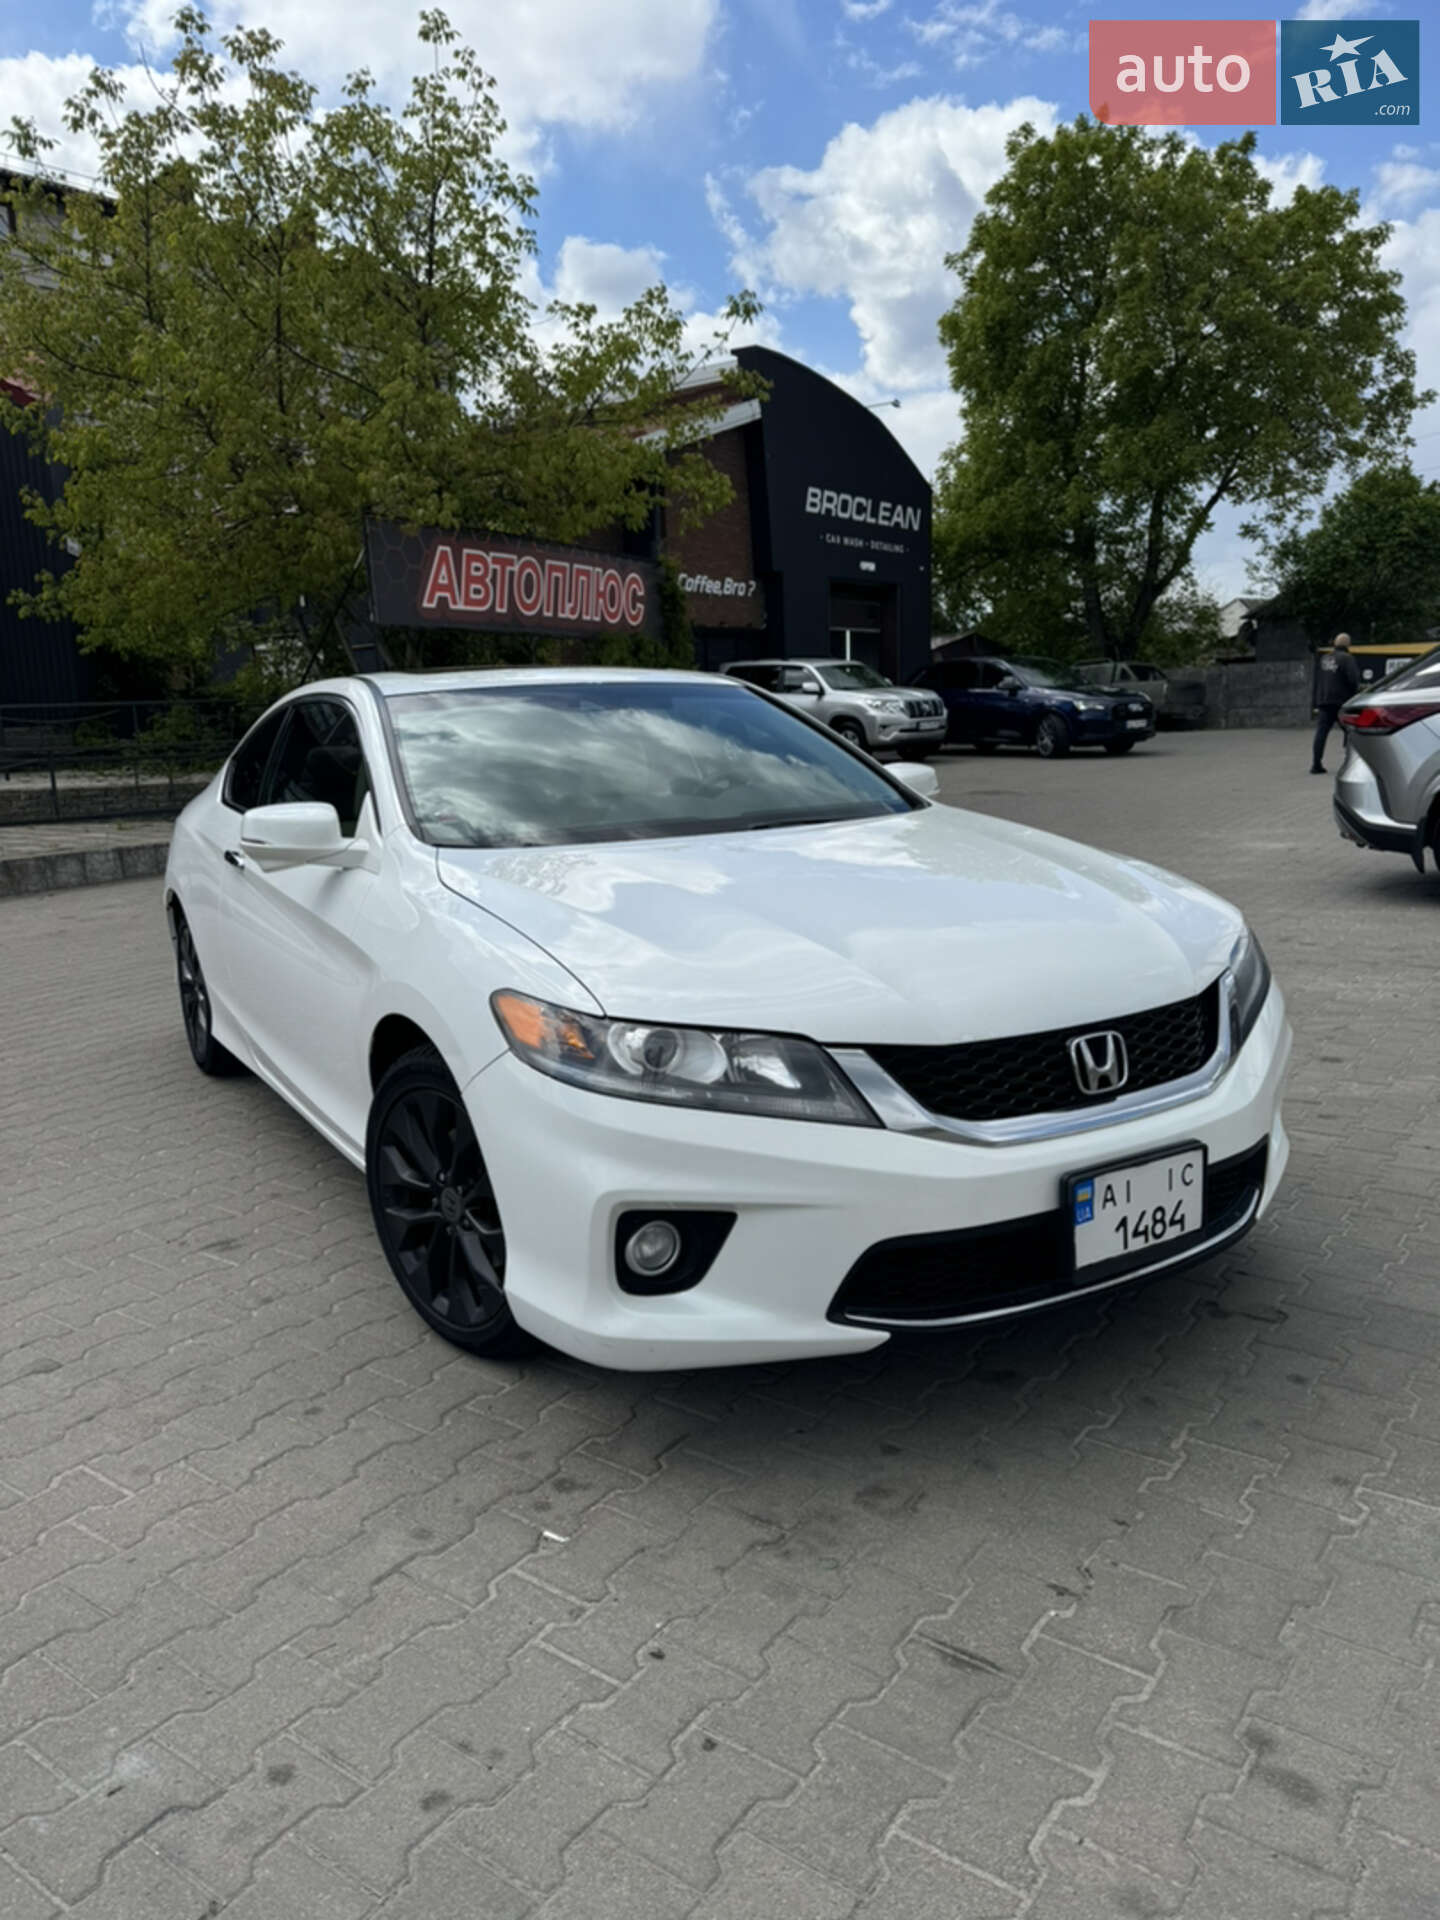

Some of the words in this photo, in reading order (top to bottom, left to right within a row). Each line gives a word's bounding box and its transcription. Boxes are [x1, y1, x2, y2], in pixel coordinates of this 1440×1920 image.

[805, 486, 922, 531] BROCLEAN
[421, 545, 645, 626] АВТОПЛЮС
[1102, 1179, 1131, 1209] AI
[1168, 1163, 1194, 1192] IC
[1115, 1199, 1186, 1251] 1484
